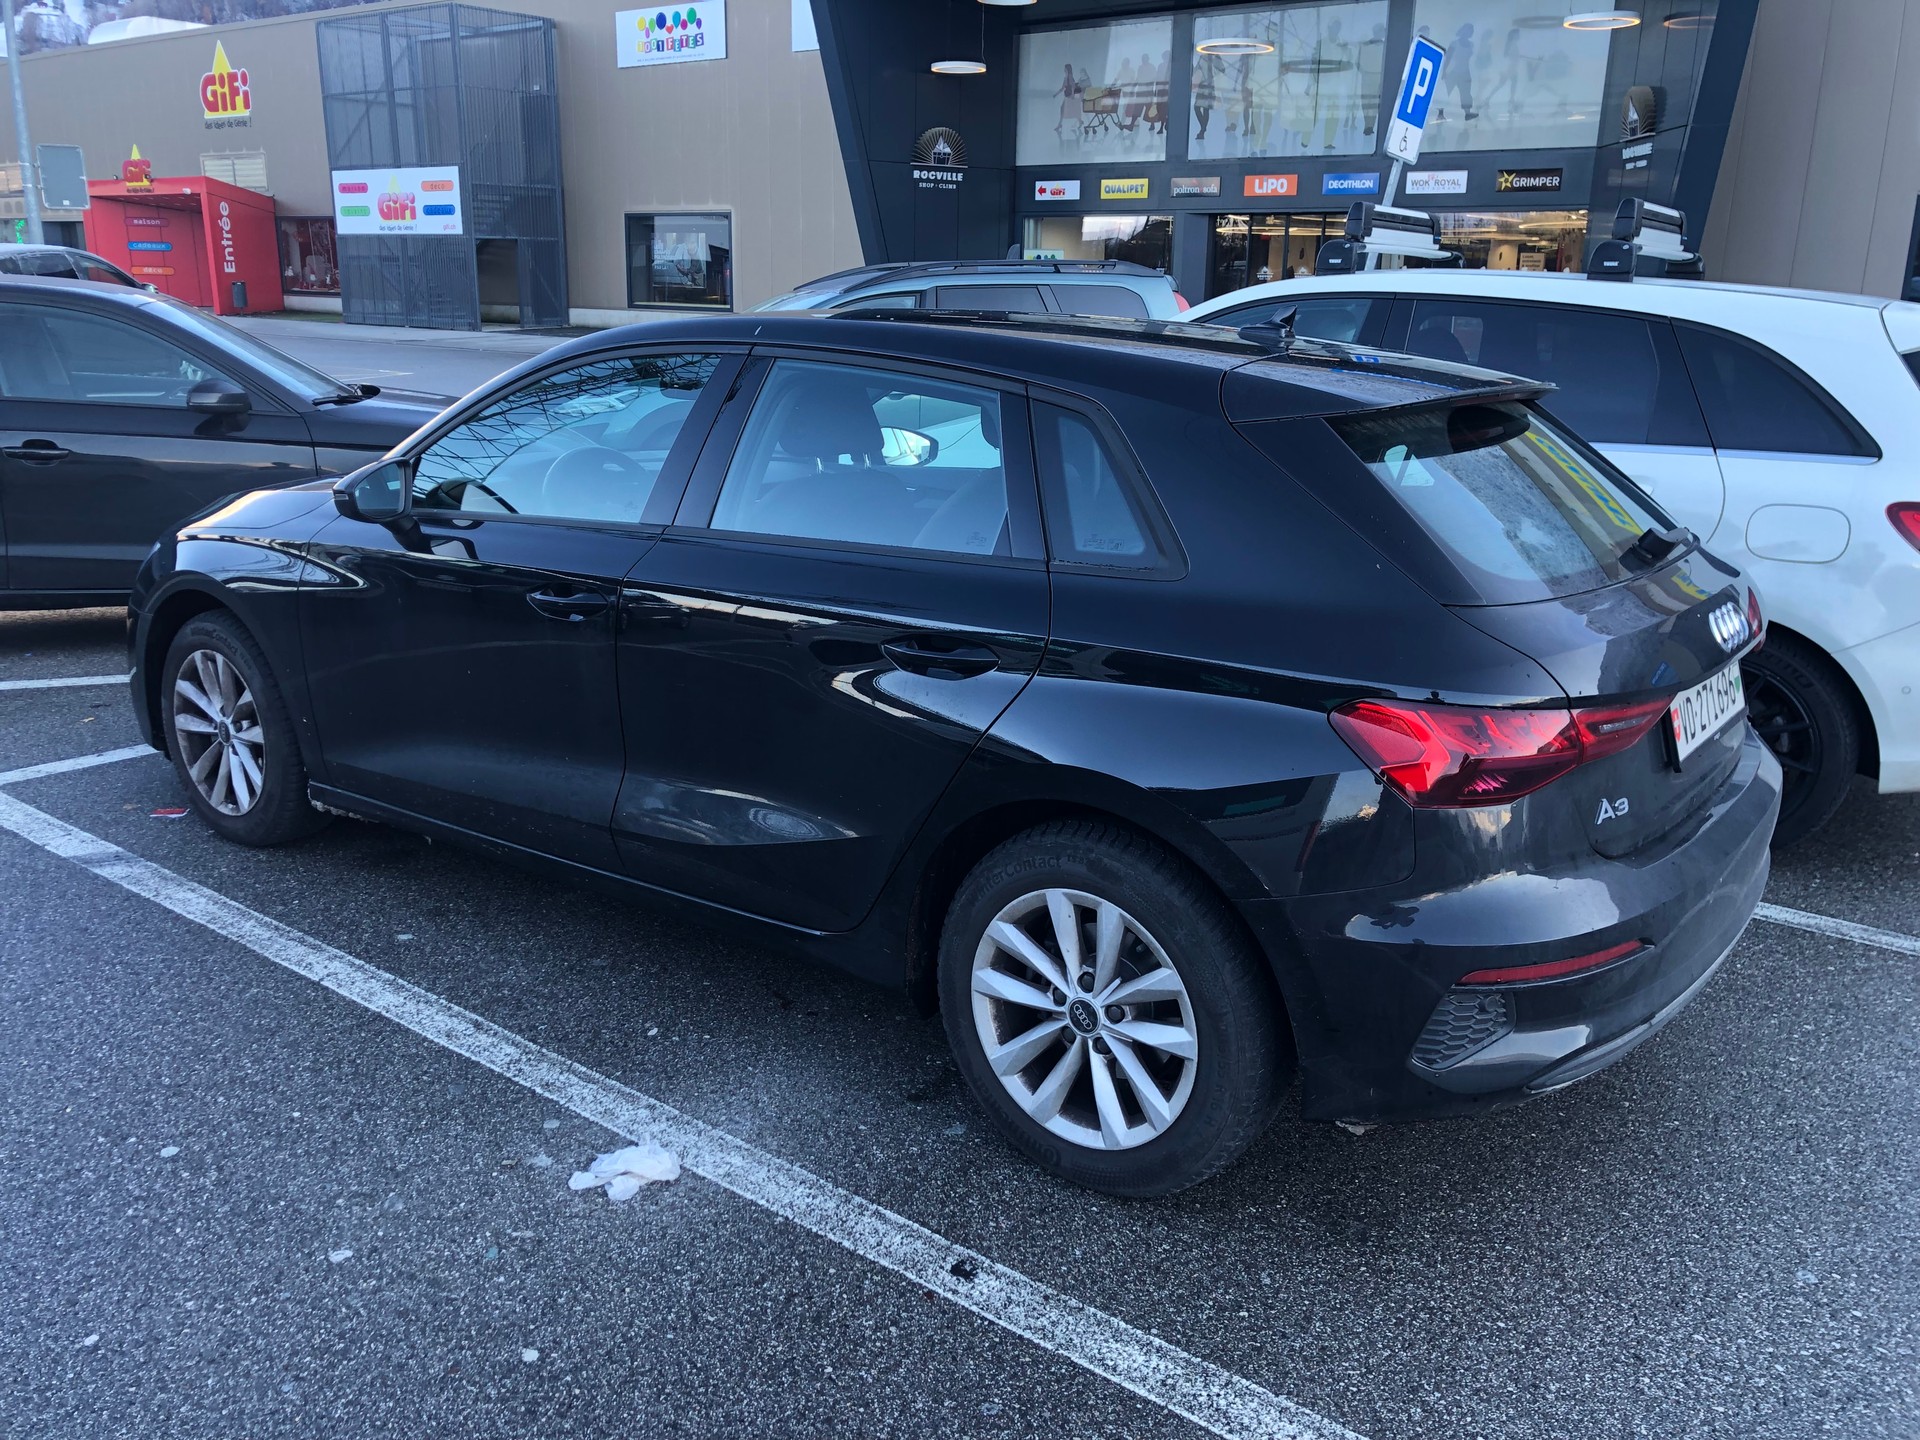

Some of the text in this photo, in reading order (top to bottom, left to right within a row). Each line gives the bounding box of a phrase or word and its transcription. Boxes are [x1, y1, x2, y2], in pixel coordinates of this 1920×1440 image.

[638, 39, 664, 53] 1001
[1406, 56, 1433, 114] P
[913, 170, 963, 181] ROCVILLE
[1328, 180, 1374, 189] DECATHLON
[1411, 178, 1461, 187] WOK ROYAL
[1513, 177, 1560, 188] GRIMPER
[1104, 183, 1145, 194] QUALIPET
[218, 201, 236, 273] Entrée
[1595, 797, 1630, 825] A3
